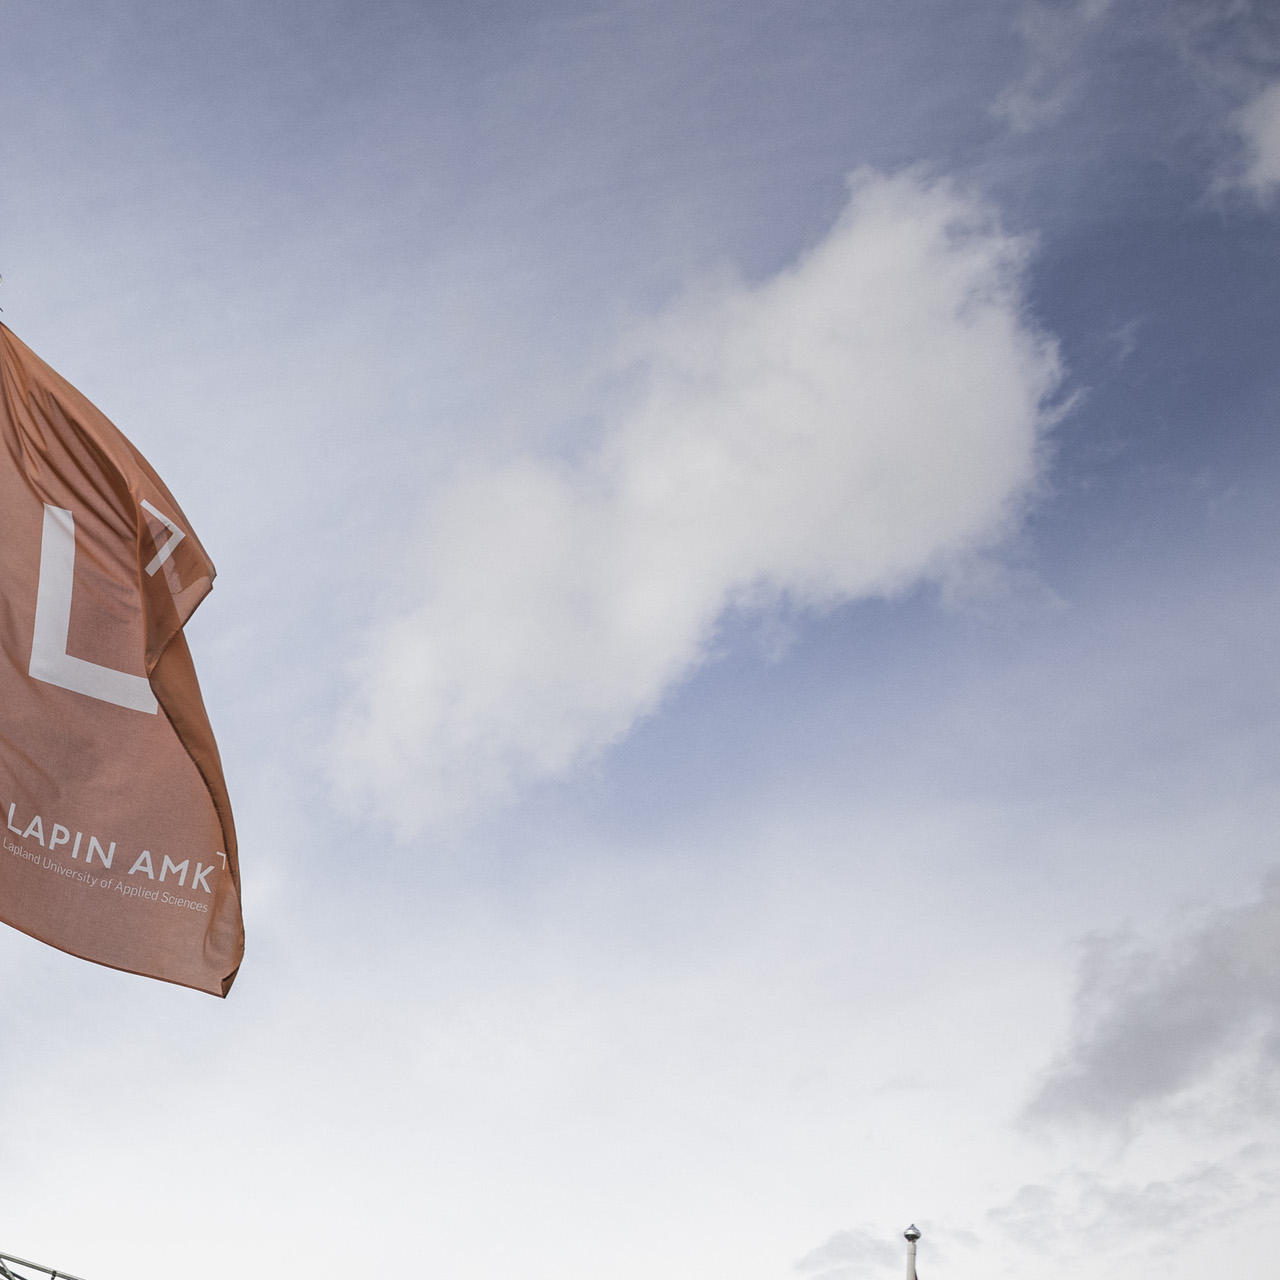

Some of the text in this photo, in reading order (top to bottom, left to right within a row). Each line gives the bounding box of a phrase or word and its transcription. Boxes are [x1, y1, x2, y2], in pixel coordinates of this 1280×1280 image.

[2, 836, 208, 913] Lapland University of Applied Sciences
[7, 802, 216, 894] LAPIN AMK
